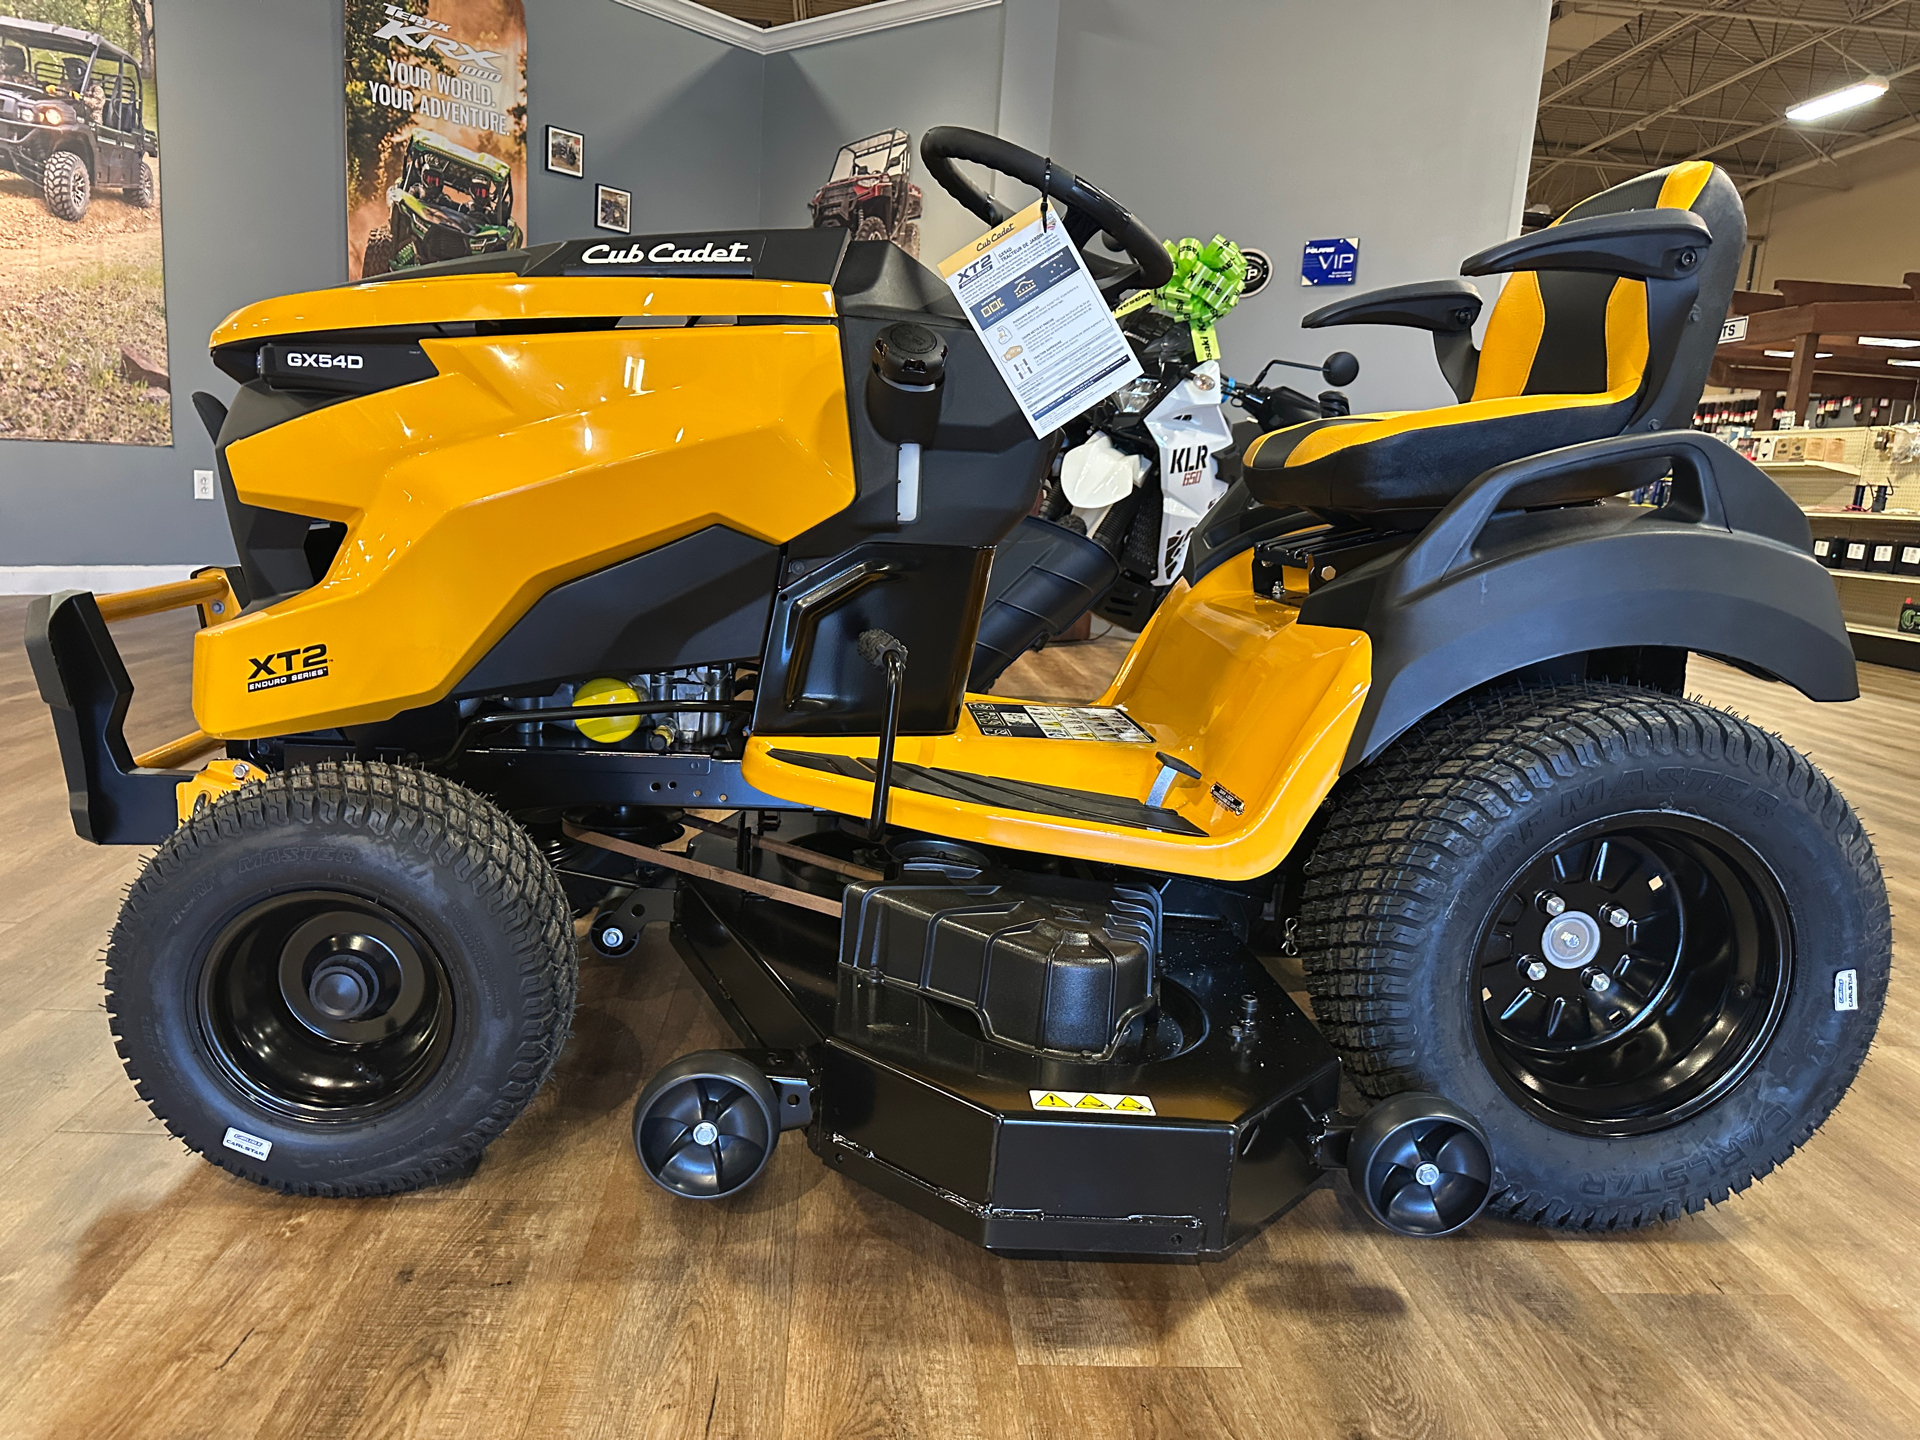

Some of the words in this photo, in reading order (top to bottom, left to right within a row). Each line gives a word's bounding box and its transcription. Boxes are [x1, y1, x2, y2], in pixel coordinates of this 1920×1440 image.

[383, 3, 452, 32] TERYX
[373, 17, 503, 71] KRX
[387, 59, 431, 91] YOUR
[437, 74, 497, 108] WORLD.
[459, 64, 503, 83] 1000
[369, 81, 414, 112] YOUR
[419, 95, 511, 136] ADVENTURE.
[976, 238, 991, 252] Cub
[989, 222, 1016, 243] Cadet
[1001, 246, 1022, 262] TRACTEUR
[1028, 232, 1044, 244] JARDIN
[581, 244, 645, 264] Cub
[1318, 253, 1354, 270] VIP
[957, 254, 993, 284] XT2
[287, 352, 364, 369] GX54D
[1170, 445, 1208, 474] KLR
[1182, 470, 1203, 487] 650
[247, 643, 328, 680] XT2
[249, 676, 287, 690] ENDURO
[291, 668, 324, 681] SERIES
[1560, 767, 1781, 819] MASTER
[238, 846, 356, 874] MASTER
[226, 1139, 265, 1157] CARLSTAR
